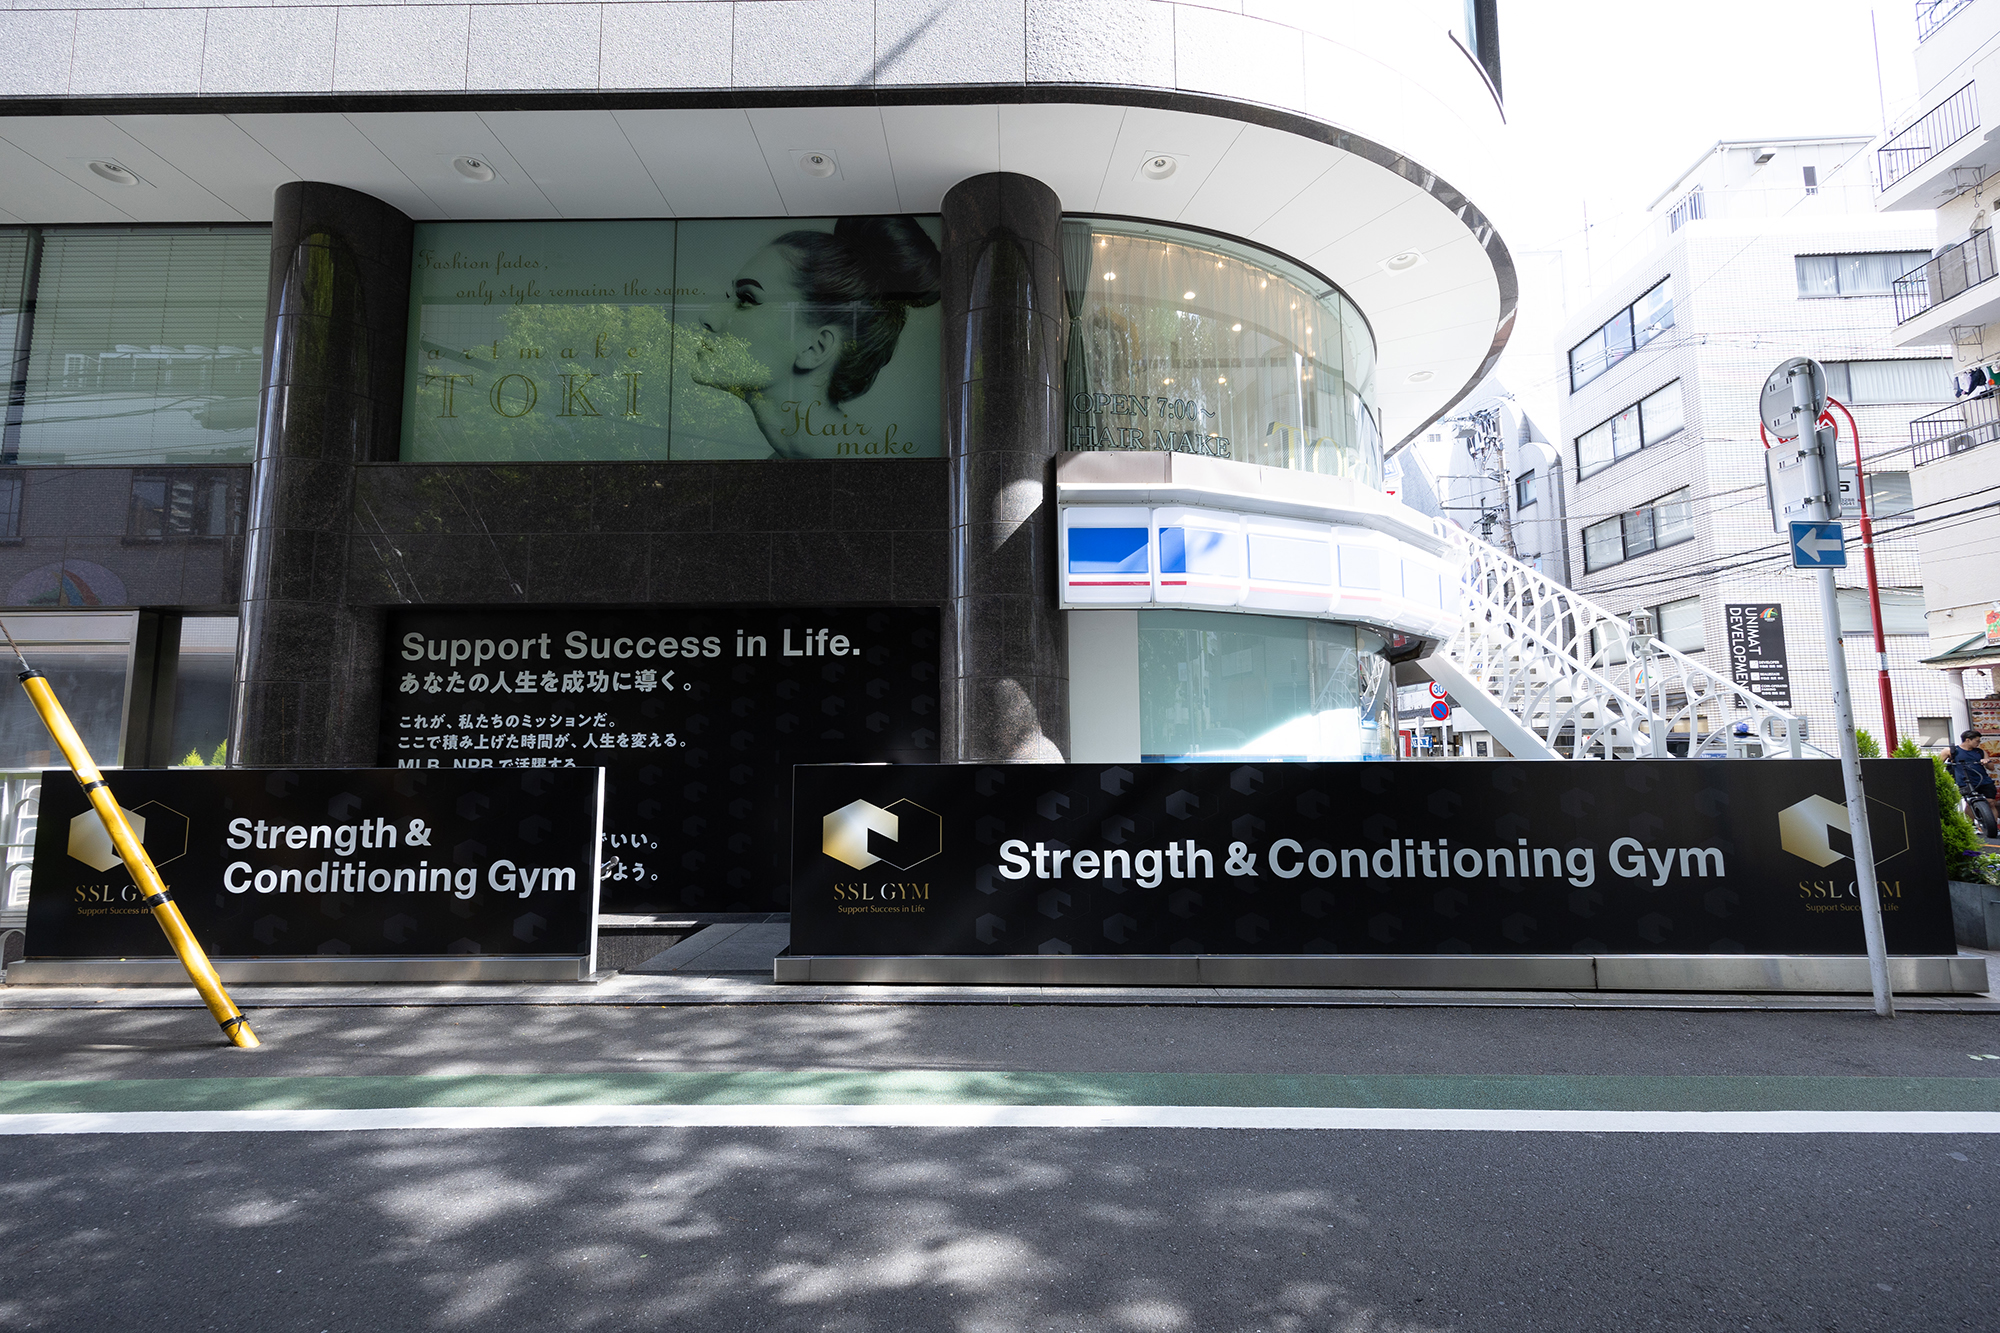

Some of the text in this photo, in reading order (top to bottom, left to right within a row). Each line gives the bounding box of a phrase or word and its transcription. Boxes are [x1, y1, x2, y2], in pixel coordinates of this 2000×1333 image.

[418, 249, 549, 276] Fashion fades,
[456, 278, 707, 306] only style remains the same.
[424, 373, 644, 418] TOKI
[1072, 391, 1150, 418] OPEN
[780, 400, 872, 437] Hair
[836, 423, 922, 455] make
[1072, 425, 1231, 459] HAIR MAKE
[1745, 607, 1762, 656] UNIMAT
[401, 628, 860, 667] Support Success in Life.
[1729, 607, 1749, 691] DEVELOPMEN
[399, 669, 692, 695] あなたの人生を成功に導く。
[399, 712, 616, 730] これが、私たちのミッションだ。
[398, 732, 686, 751] ここで積み上げた時間が、人生を変える。
[226, 817, 432, 857] Strength &
[998, 836, 1726, 889] Strength & Conditioning Gym
[74, 884, 115, 901] SSL
[223, 859, 576, 900] Conditioning Gym
[833, 882, 930, 901] SSL GYM
[1799, 880, 1843, 899] SSL
[78, 906, 108, 918] Support
[109, 906, 141, 915] Success
[837, 903, 926, 916] Support Success in Life
[1805, 903, 1838, 914] Support
[1884, 902, 1899, 911] Life
